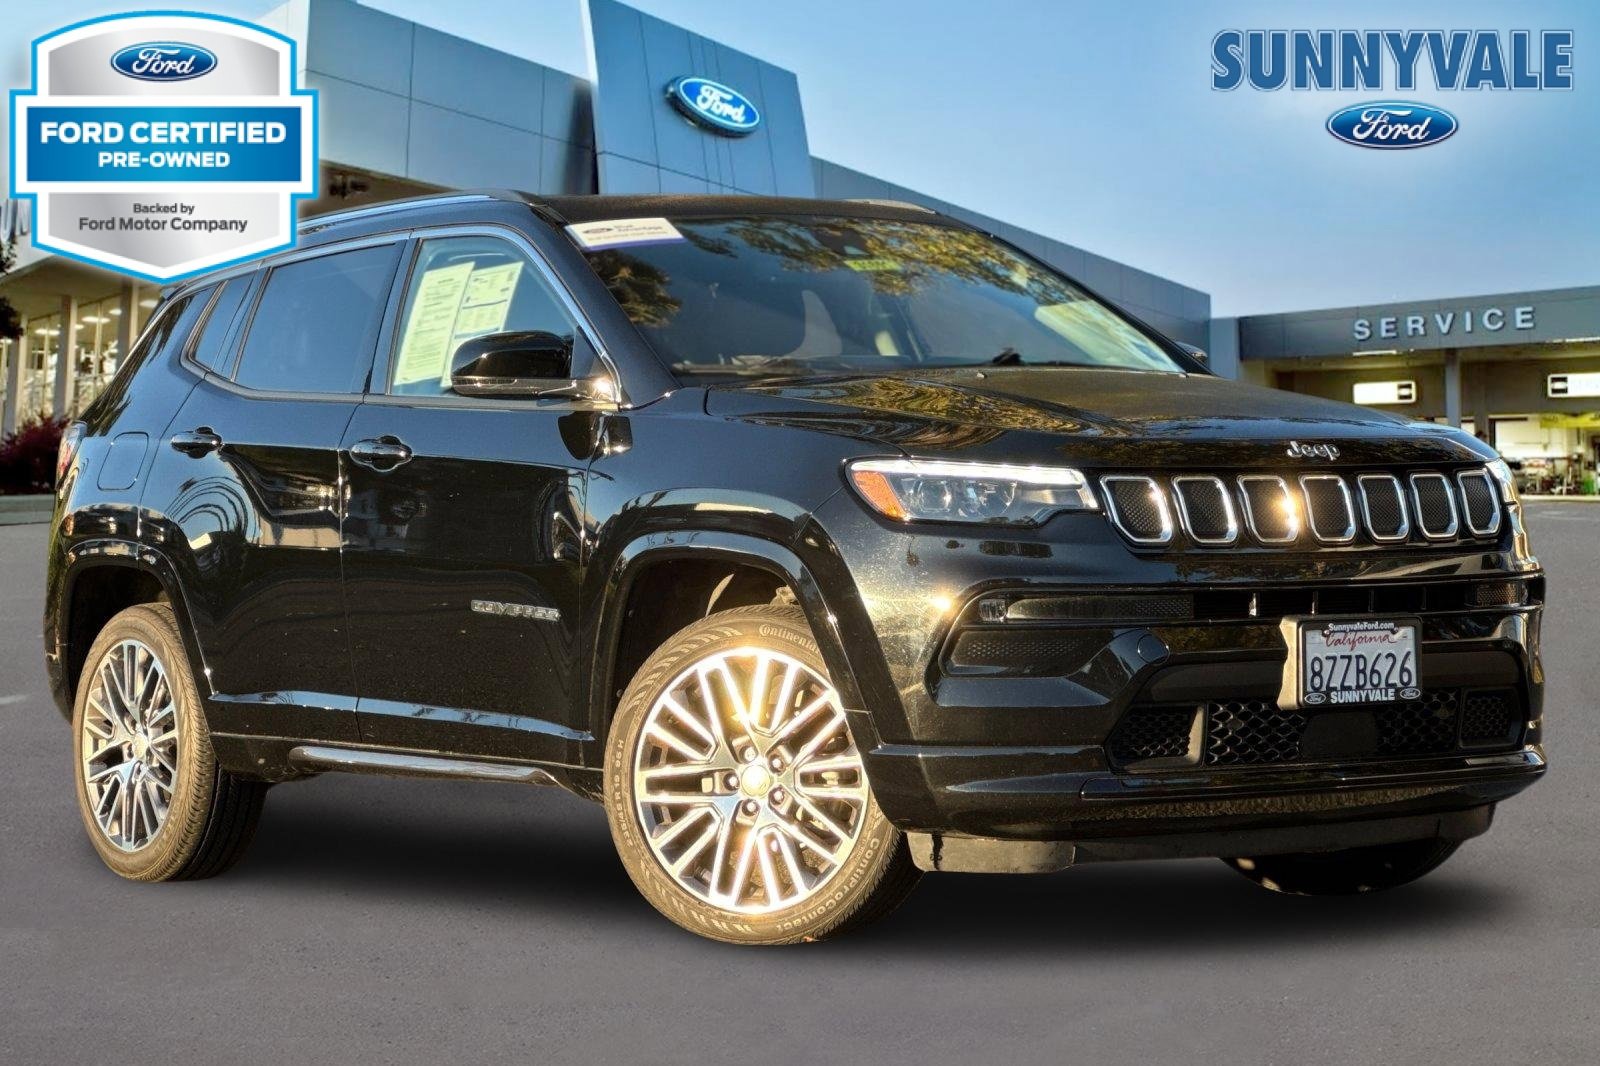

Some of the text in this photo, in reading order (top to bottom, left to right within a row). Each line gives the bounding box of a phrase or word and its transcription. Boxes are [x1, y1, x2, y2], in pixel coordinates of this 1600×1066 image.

[696, 84, 746, 124] Ford
[1353, 305, 1536, 341] SERVICE
[1286, 440, 1341, 461] Jeep
[1328, 621, 1395, 633] SunnyvaleFord.com
[1325, 632, 1397, 652] California
[1310, 650, 1413, 692] 8ZZB626
[1330, 688, 1396, 704] SUNNYVALE
